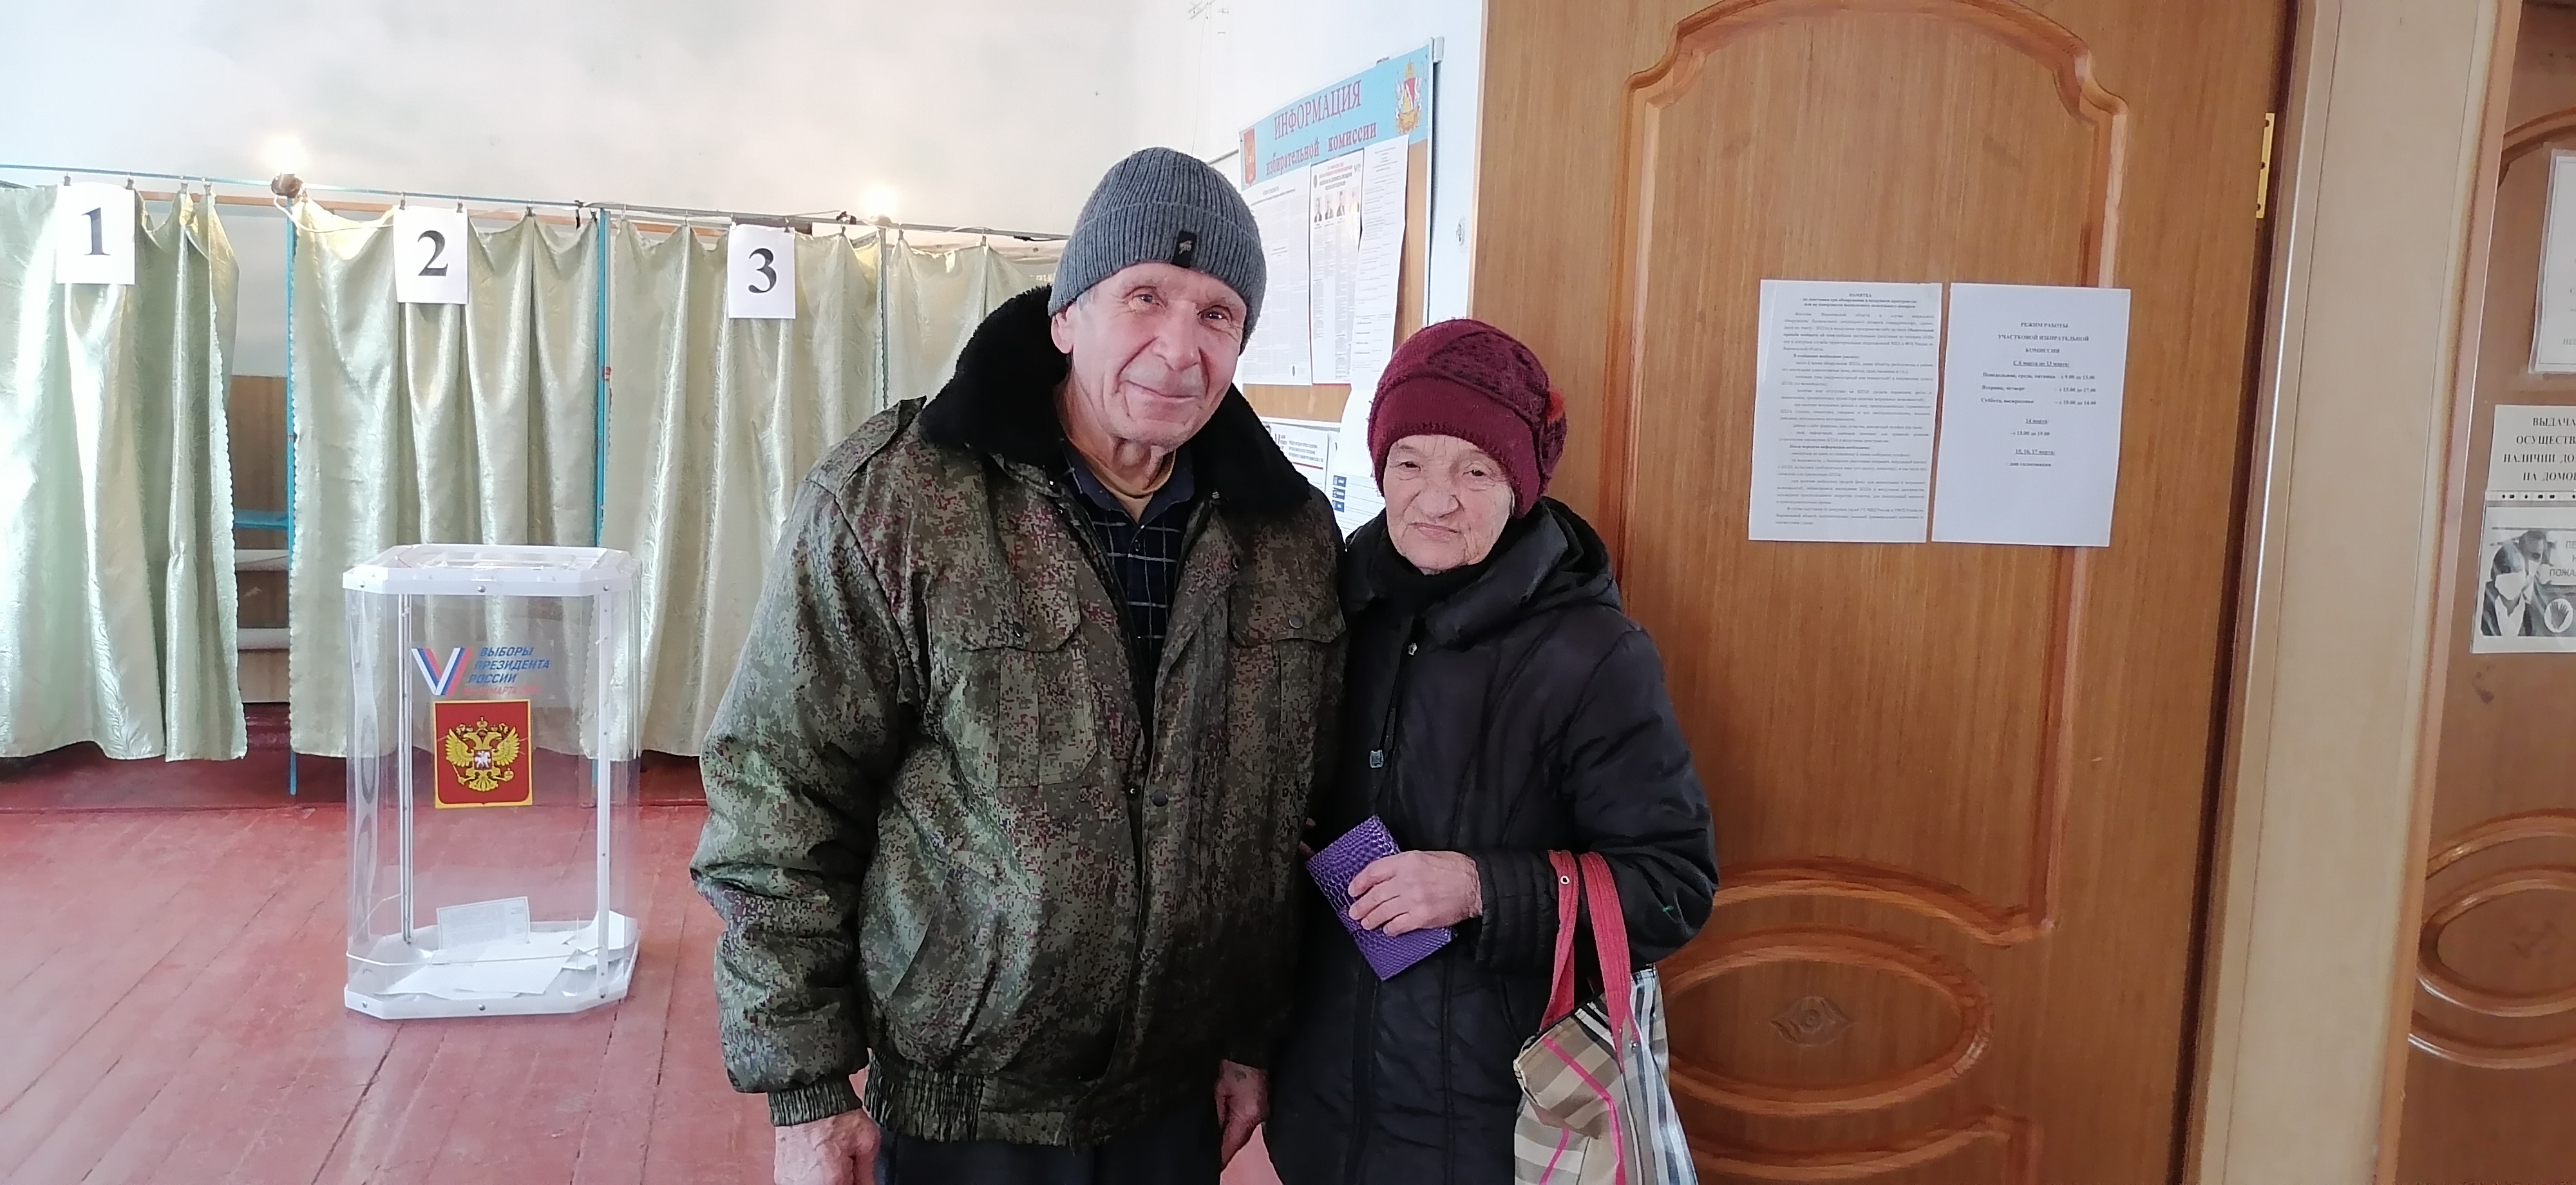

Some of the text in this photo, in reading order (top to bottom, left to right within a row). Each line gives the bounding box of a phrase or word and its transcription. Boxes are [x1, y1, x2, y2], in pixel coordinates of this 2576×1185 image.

[1274, 80, 1361, 140] ИНФОРМАЦИЯ
[1266, 122, 1377, 175] избирательной комиссии
[81, 207, 111, 256] 1
[417, 229, 449, 277] 2
[748, 248, 777, 294] 3
[2533, 417, 2576, 426] ВЫДАЧА
[2516, 435, 2576, 446] ОСУЩЕСТВ
[2503, 453, 2555, 463] НАЛИЧИИ
[2523, 472, 2537, 481] НА
[480, 647, 534, 657] ВЫБОРЫ
[474, 659, 550, 671] ПРЕЗИДЕНТА
[468, 674, 518, 684] РОССИИ
